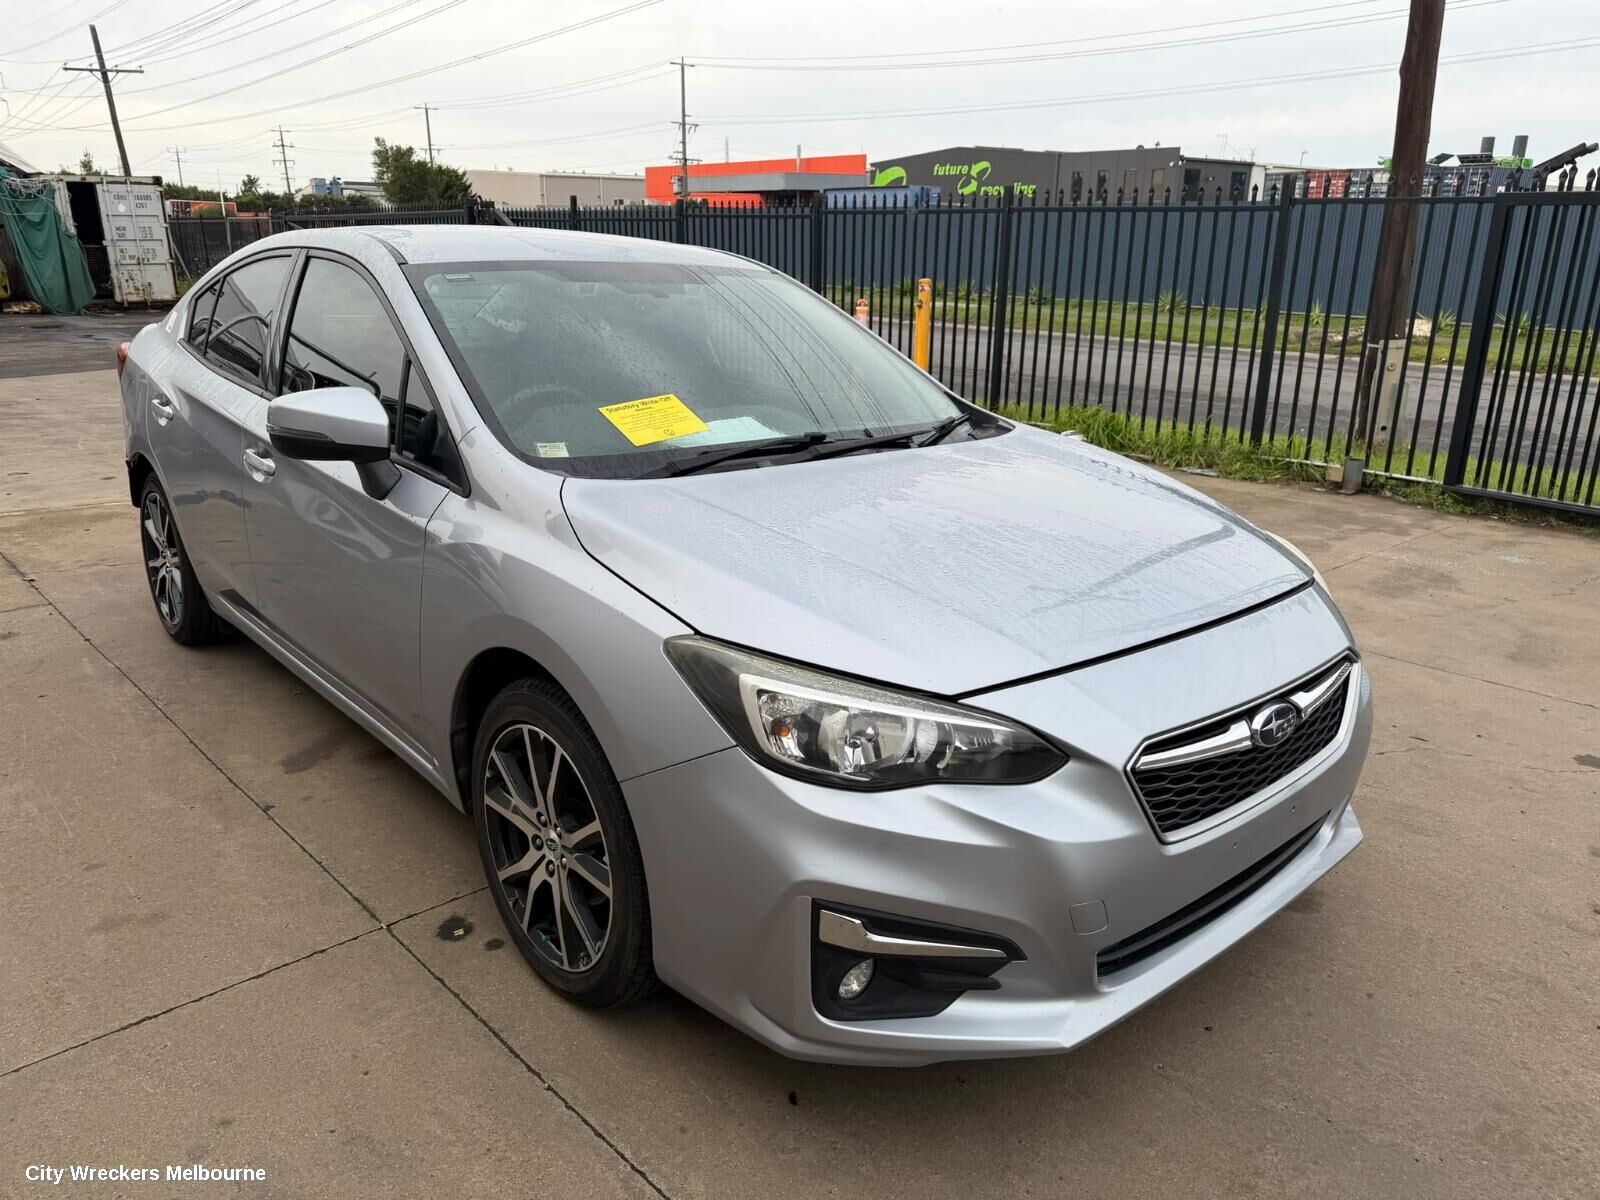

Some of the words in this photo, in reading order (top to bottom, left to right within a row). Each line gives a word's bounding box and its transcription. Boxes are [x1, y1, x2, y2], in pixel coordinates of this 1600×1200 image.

[933, 163, 968, 175] future
[980, 182, 1036, 198] recyling
[606, 402, 639, 413] Statutory
